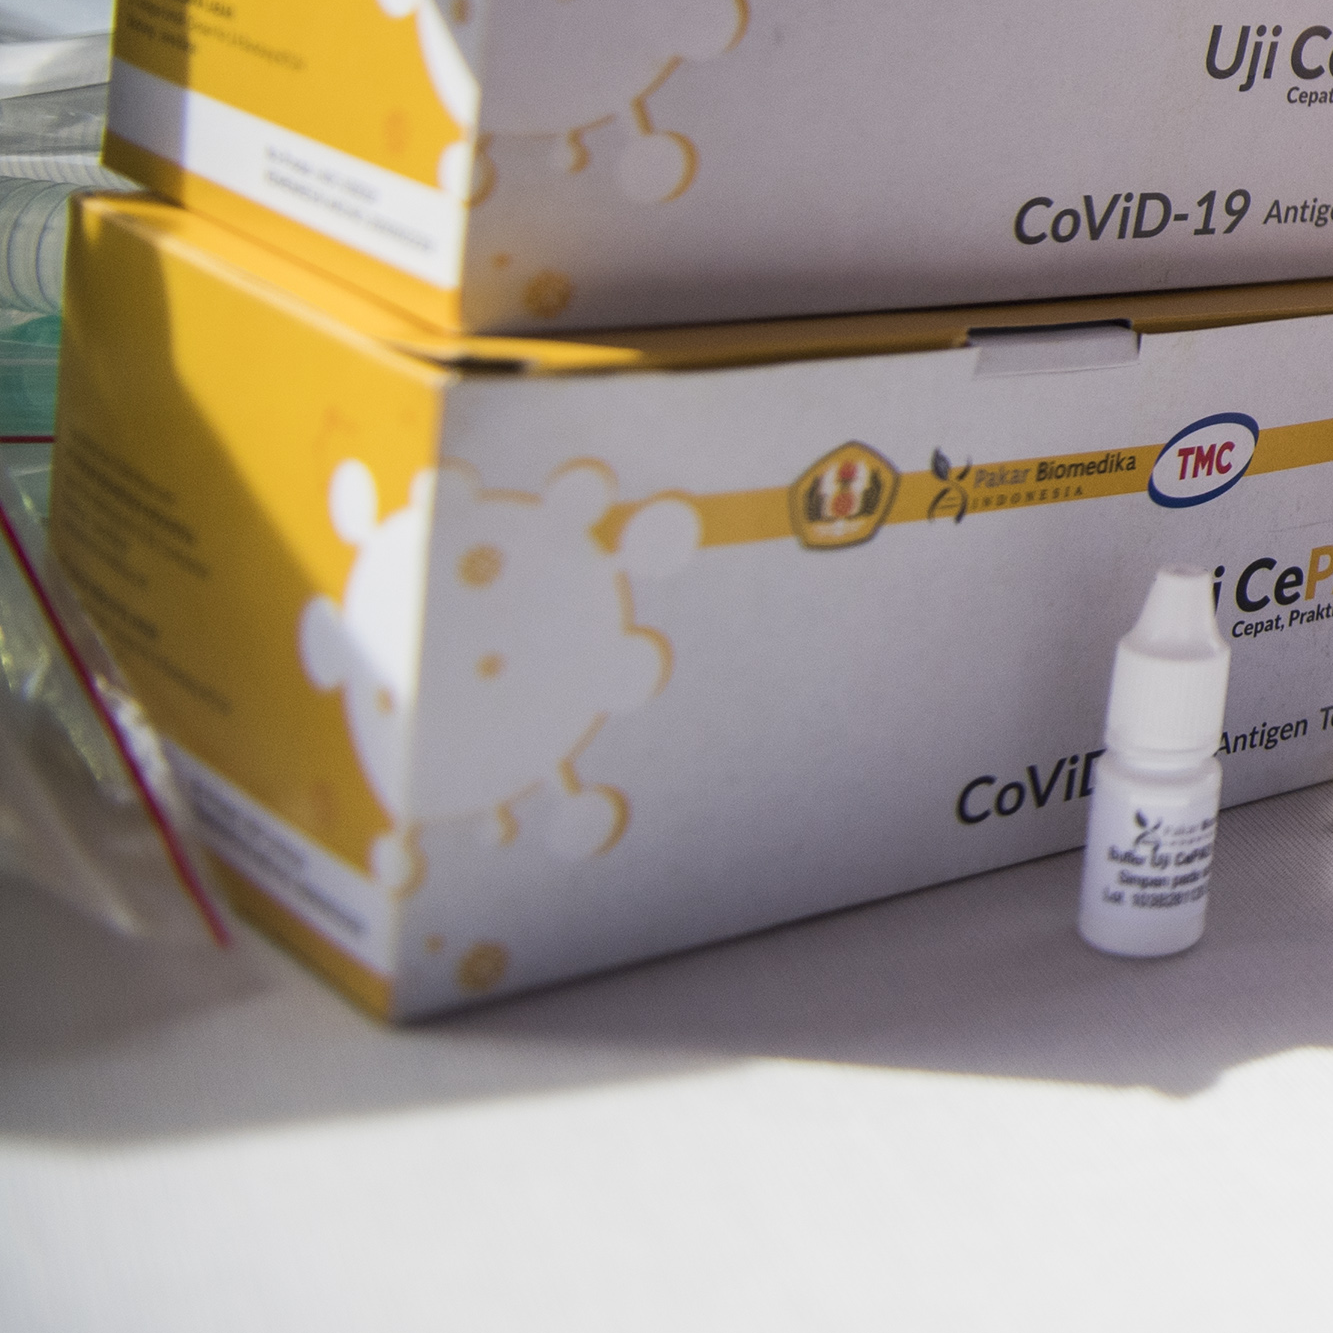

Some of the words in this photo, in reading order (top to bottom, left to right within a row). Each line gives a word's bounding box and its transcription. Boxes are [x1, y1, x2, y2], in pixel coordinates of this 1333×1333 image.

[1206, 25, 1282, 92] Uji
[1013, 188, 1252, 245] CoViD-19
[973, 466, 1031, 489] Pakar
[1035, 451, 1137, 482] Biomedika
[1178, 441, 1235, 481] TMC
[1231, 614, 1284, 639] Cepat,
[1215, 718, 1308, 757] Antigen
